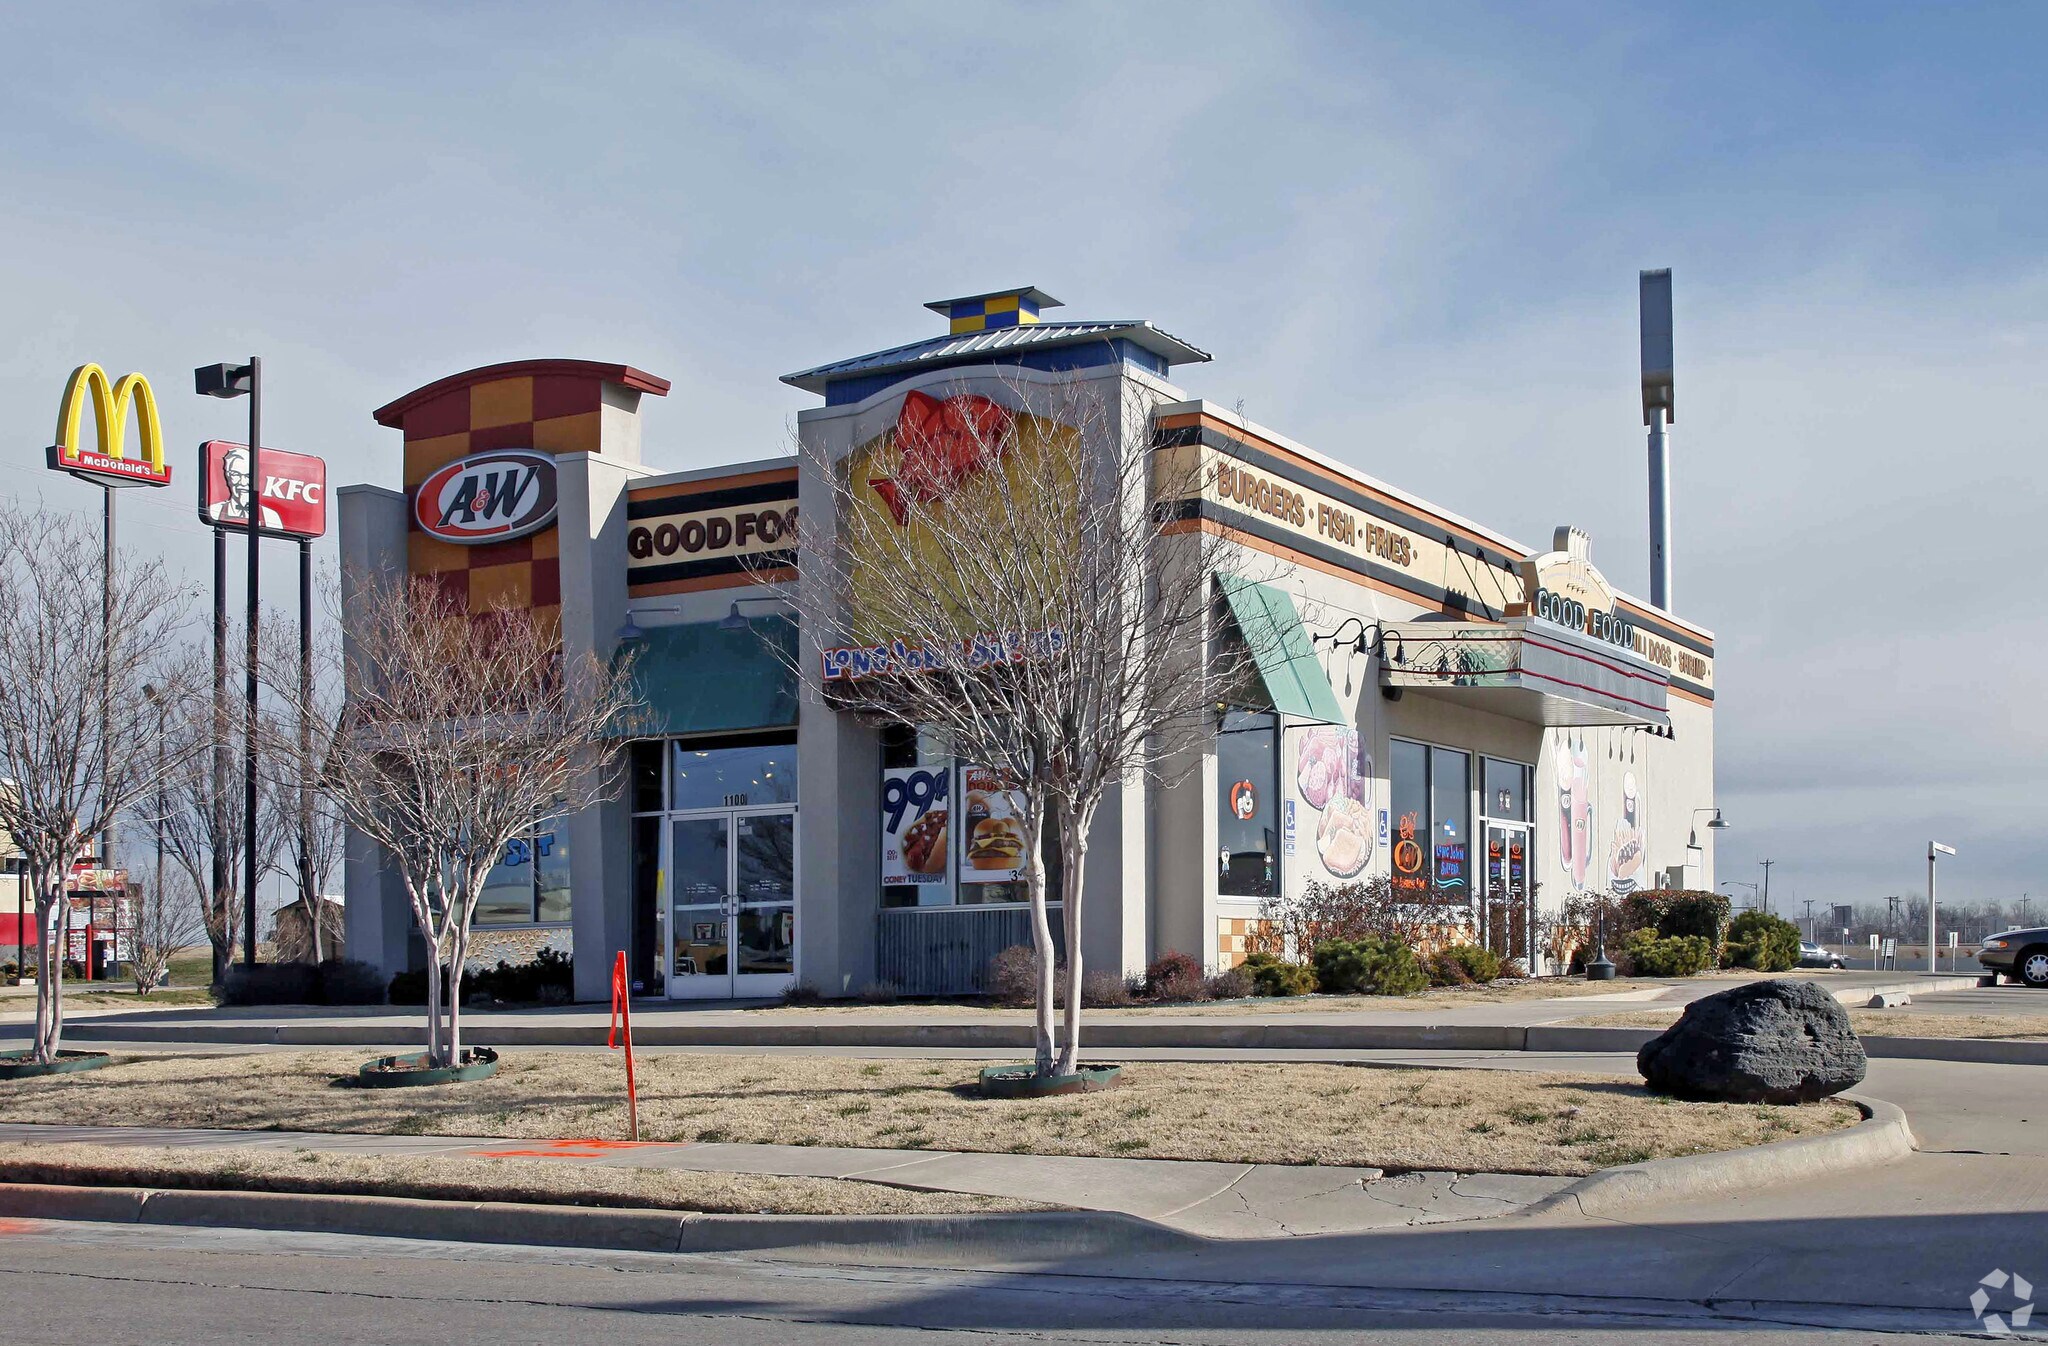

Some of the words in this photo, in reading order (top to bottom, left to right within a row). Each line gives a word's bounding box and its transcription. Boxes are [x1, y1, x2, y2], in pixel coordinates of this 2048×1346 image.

[83, 455, 151, 475] McDonald's
[262, 475, 321, 504] KFC
[435, 464, 542, 529] A&W
[1217, 460, 1305, 528] BURGERS
[1317, 502, 1356, 548] FISH
[1365, 522, 1411, 568] FRIES
[627, 516, 732, 560] GOOD
[1535, 588, 1586, 632] GOOD
[1588, 609, 1635, 650] FOOD
[823, 646, 890, 680] LONG
[1648, 638, 1673, 669] DOGS
[1678, 649, 1707, 681] SHRIMP
[724, 794, 746, 807] 1100
[907, 873, 943, 884] TUESDAY
